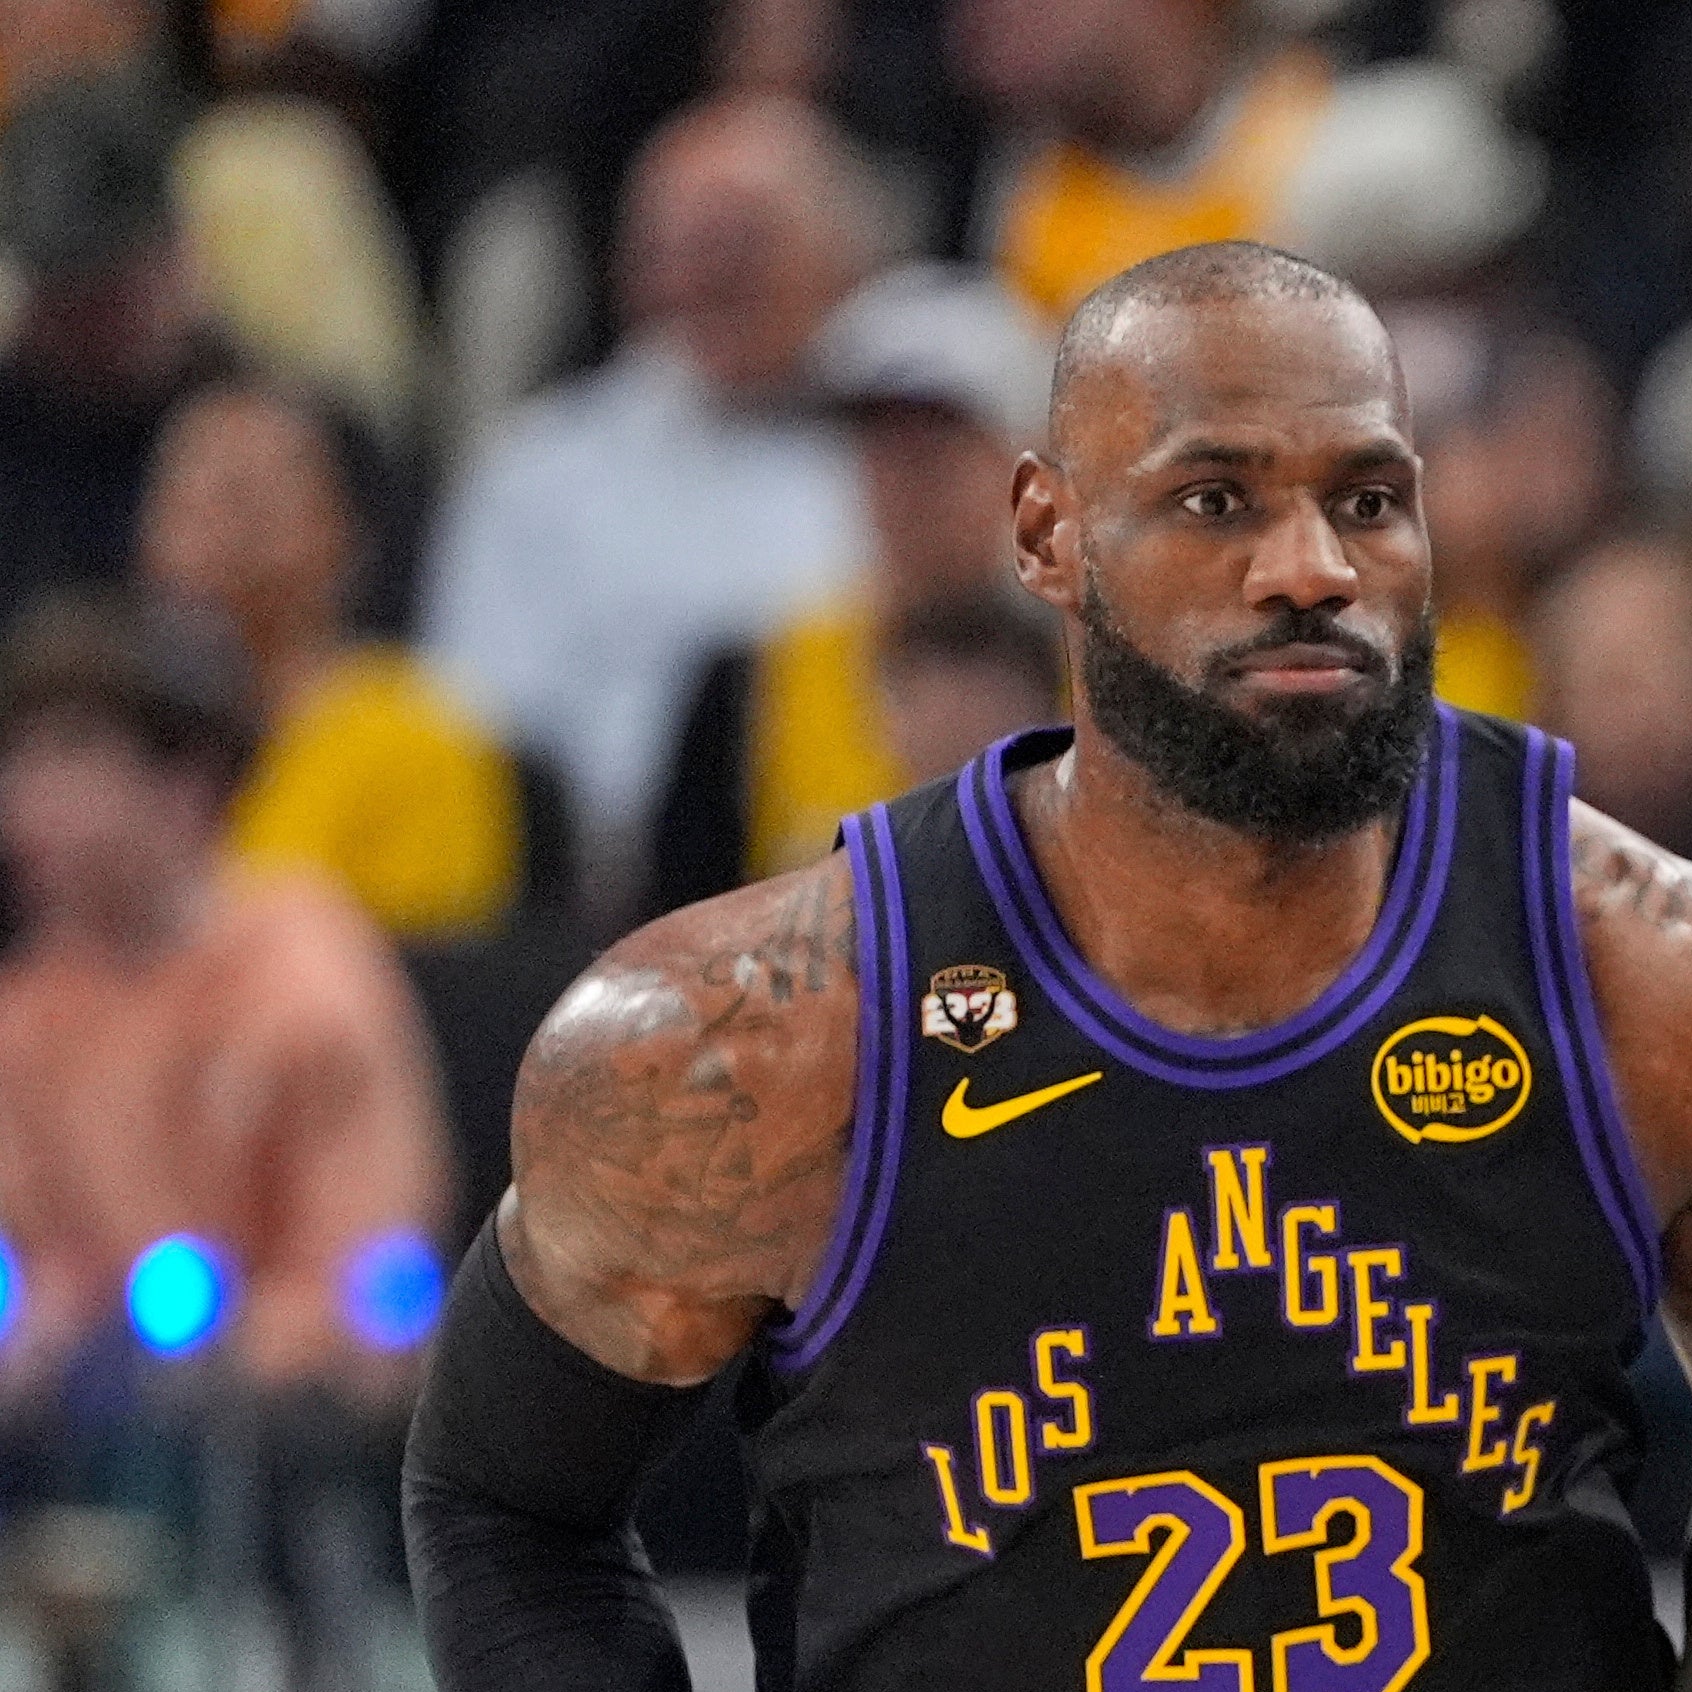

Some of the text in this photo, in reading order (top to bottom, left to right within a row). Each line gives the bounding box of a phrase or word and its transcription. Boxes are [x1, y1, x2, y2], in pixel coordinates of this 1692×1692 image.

[1385, 1049, 1521, 1104] bibigo
[926, 1143, 1557, 1556] LOS ANGELES
